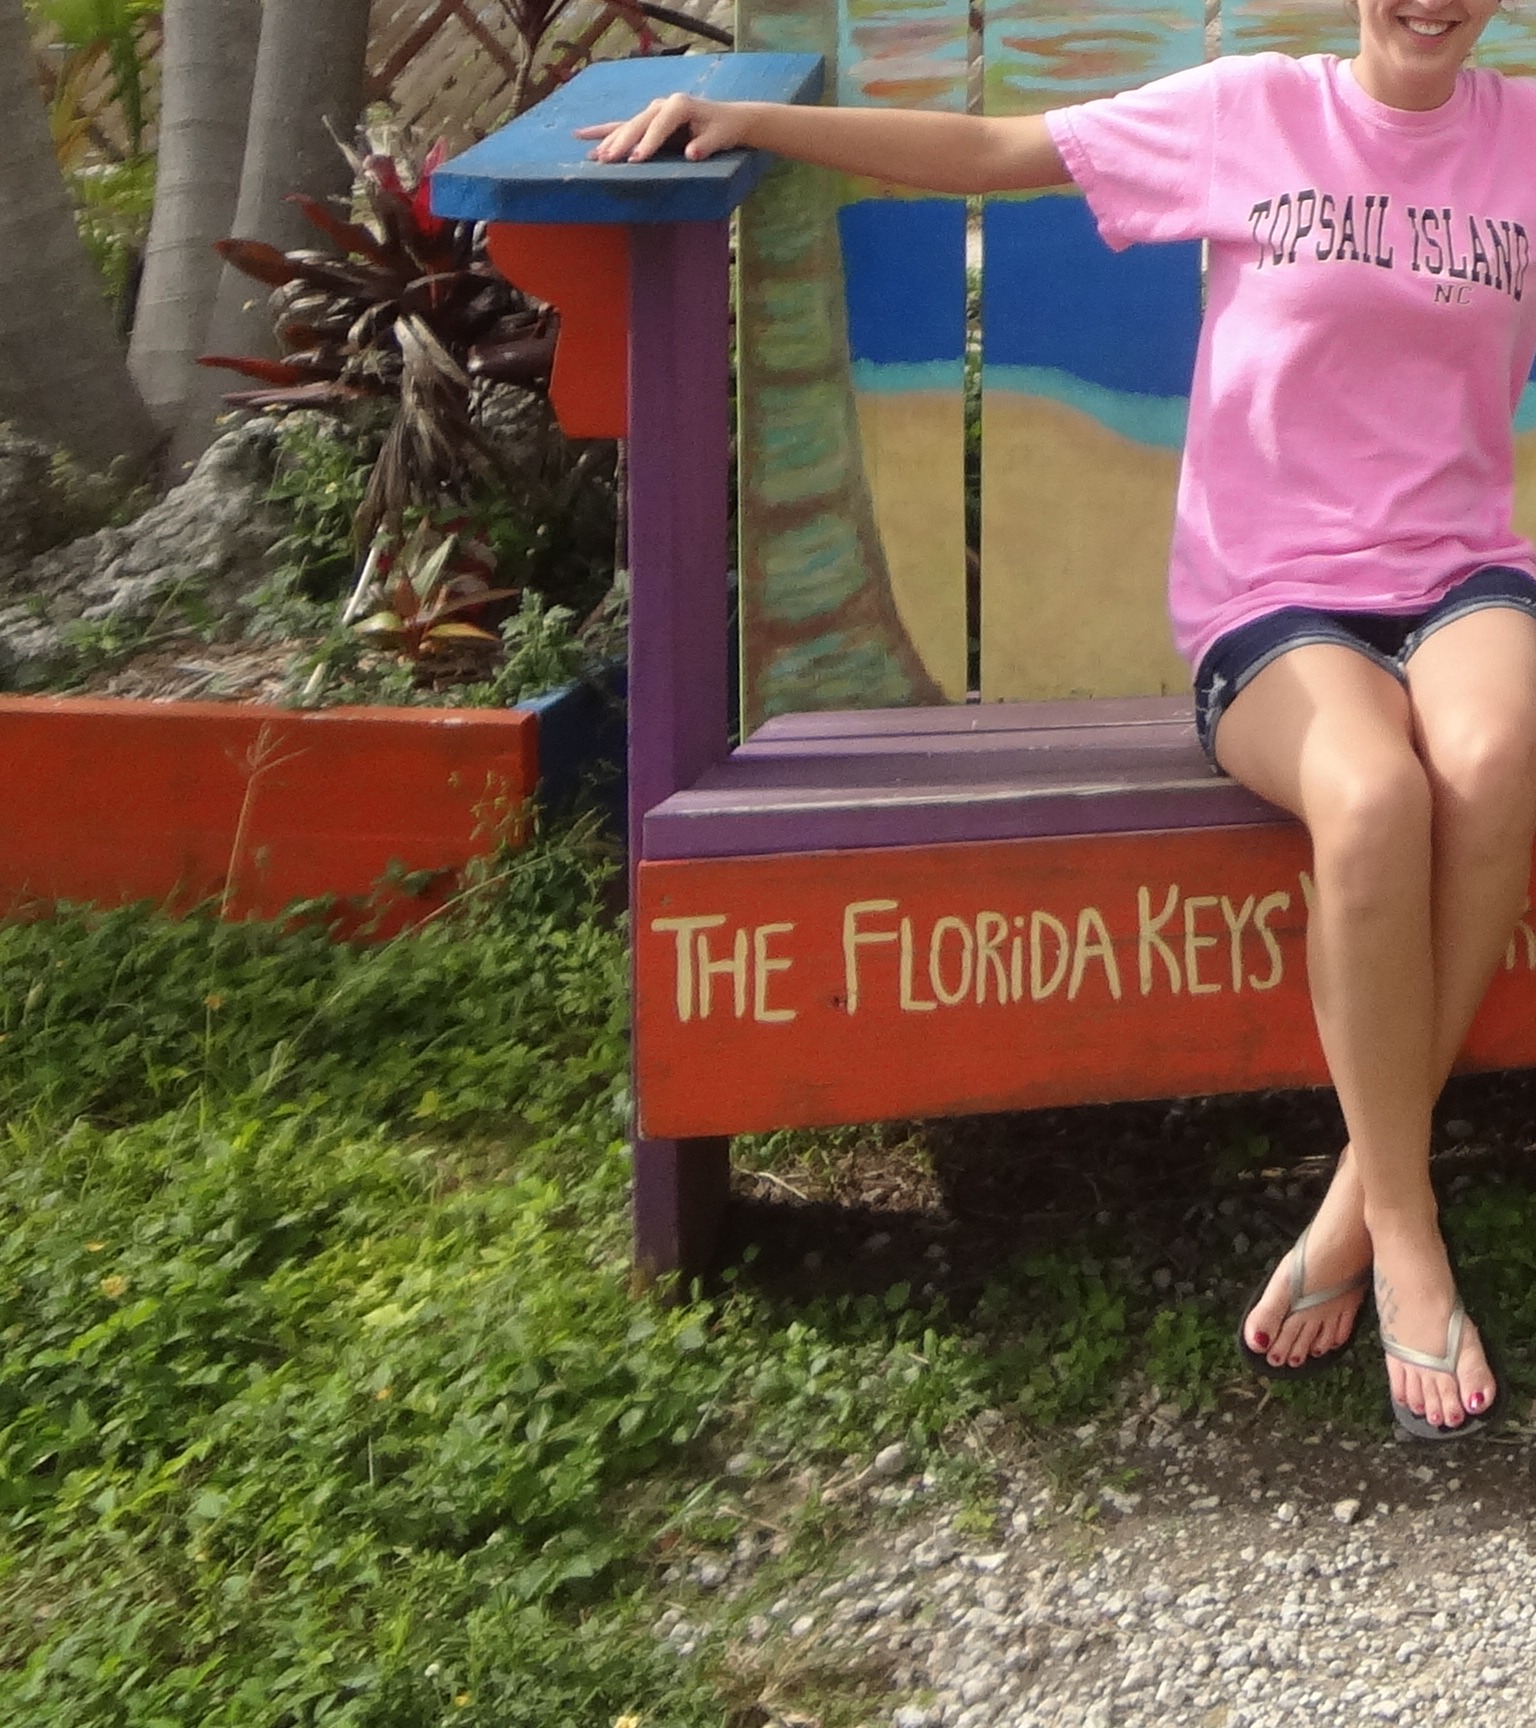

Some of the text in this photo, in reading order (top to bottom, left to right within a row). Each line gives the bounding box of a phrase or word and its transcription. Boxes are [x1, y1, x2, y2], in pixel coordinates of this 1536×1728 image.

[1248, 189, 1530, 303] TOPSAIL ISLAND
[1434, 283, 1473, 305] NC
[651, 914, 797, 1023] THE
